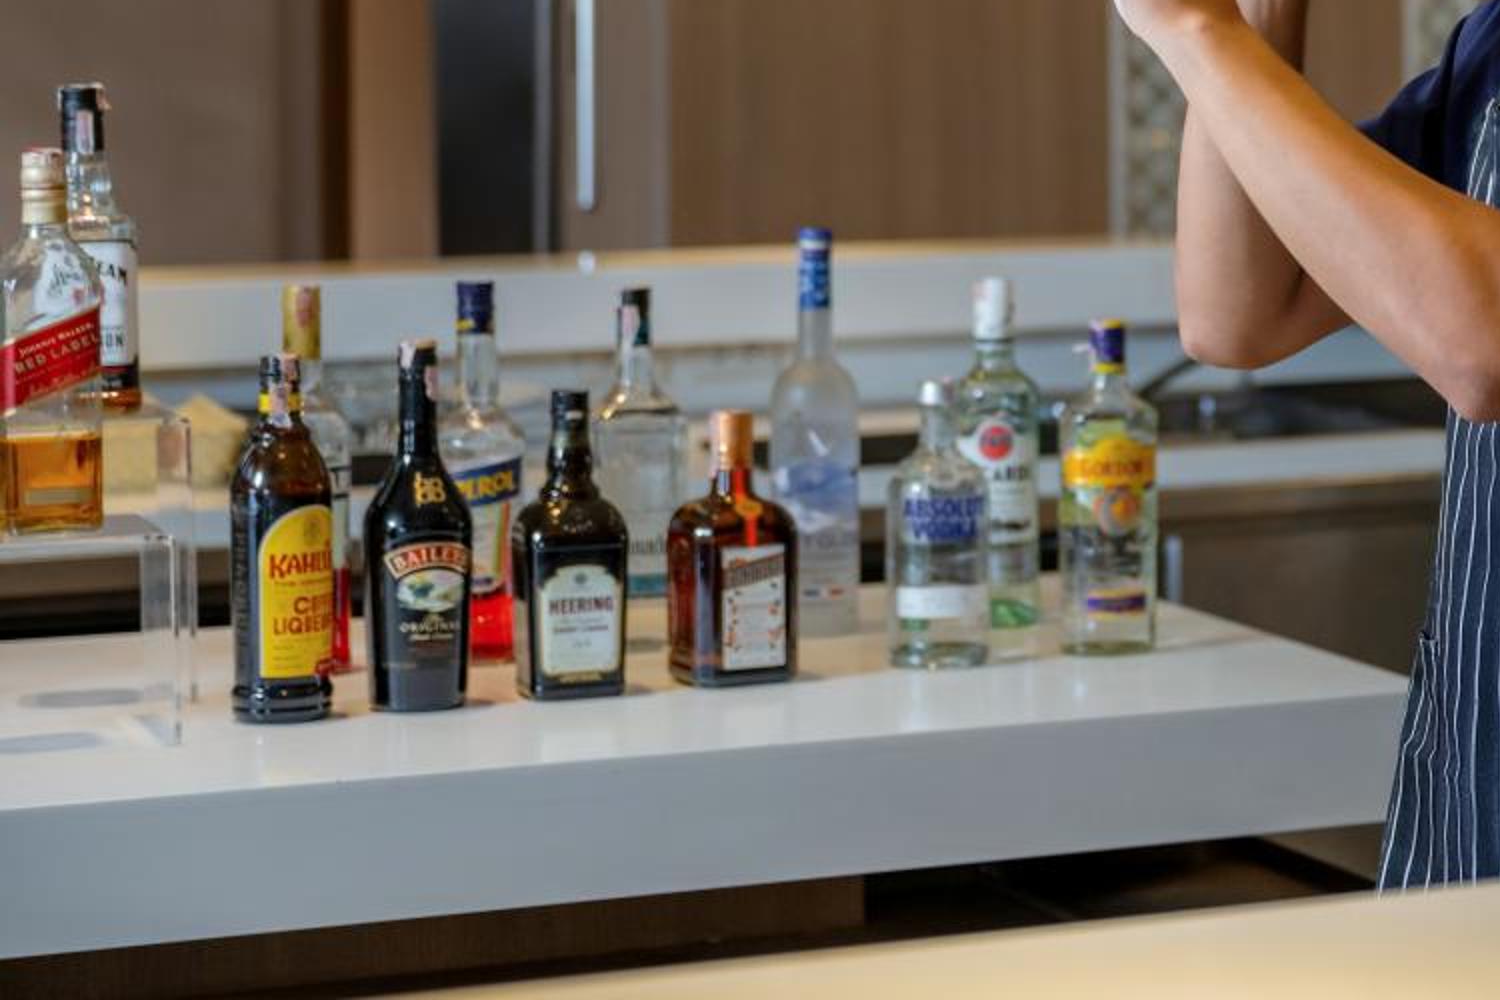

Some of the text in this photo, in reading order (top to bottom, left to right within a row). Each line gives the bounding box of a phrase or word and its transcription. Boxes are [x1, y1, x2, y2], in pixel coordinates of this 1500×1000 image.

[15, 352, 48, 375] RED
[50, 334, 100, 361] LABEL
[903, 496, 984, 518] ABSOLUT
[913, 518, 977, 541] VODKA
[549, 596, 614, 616] HEERING
